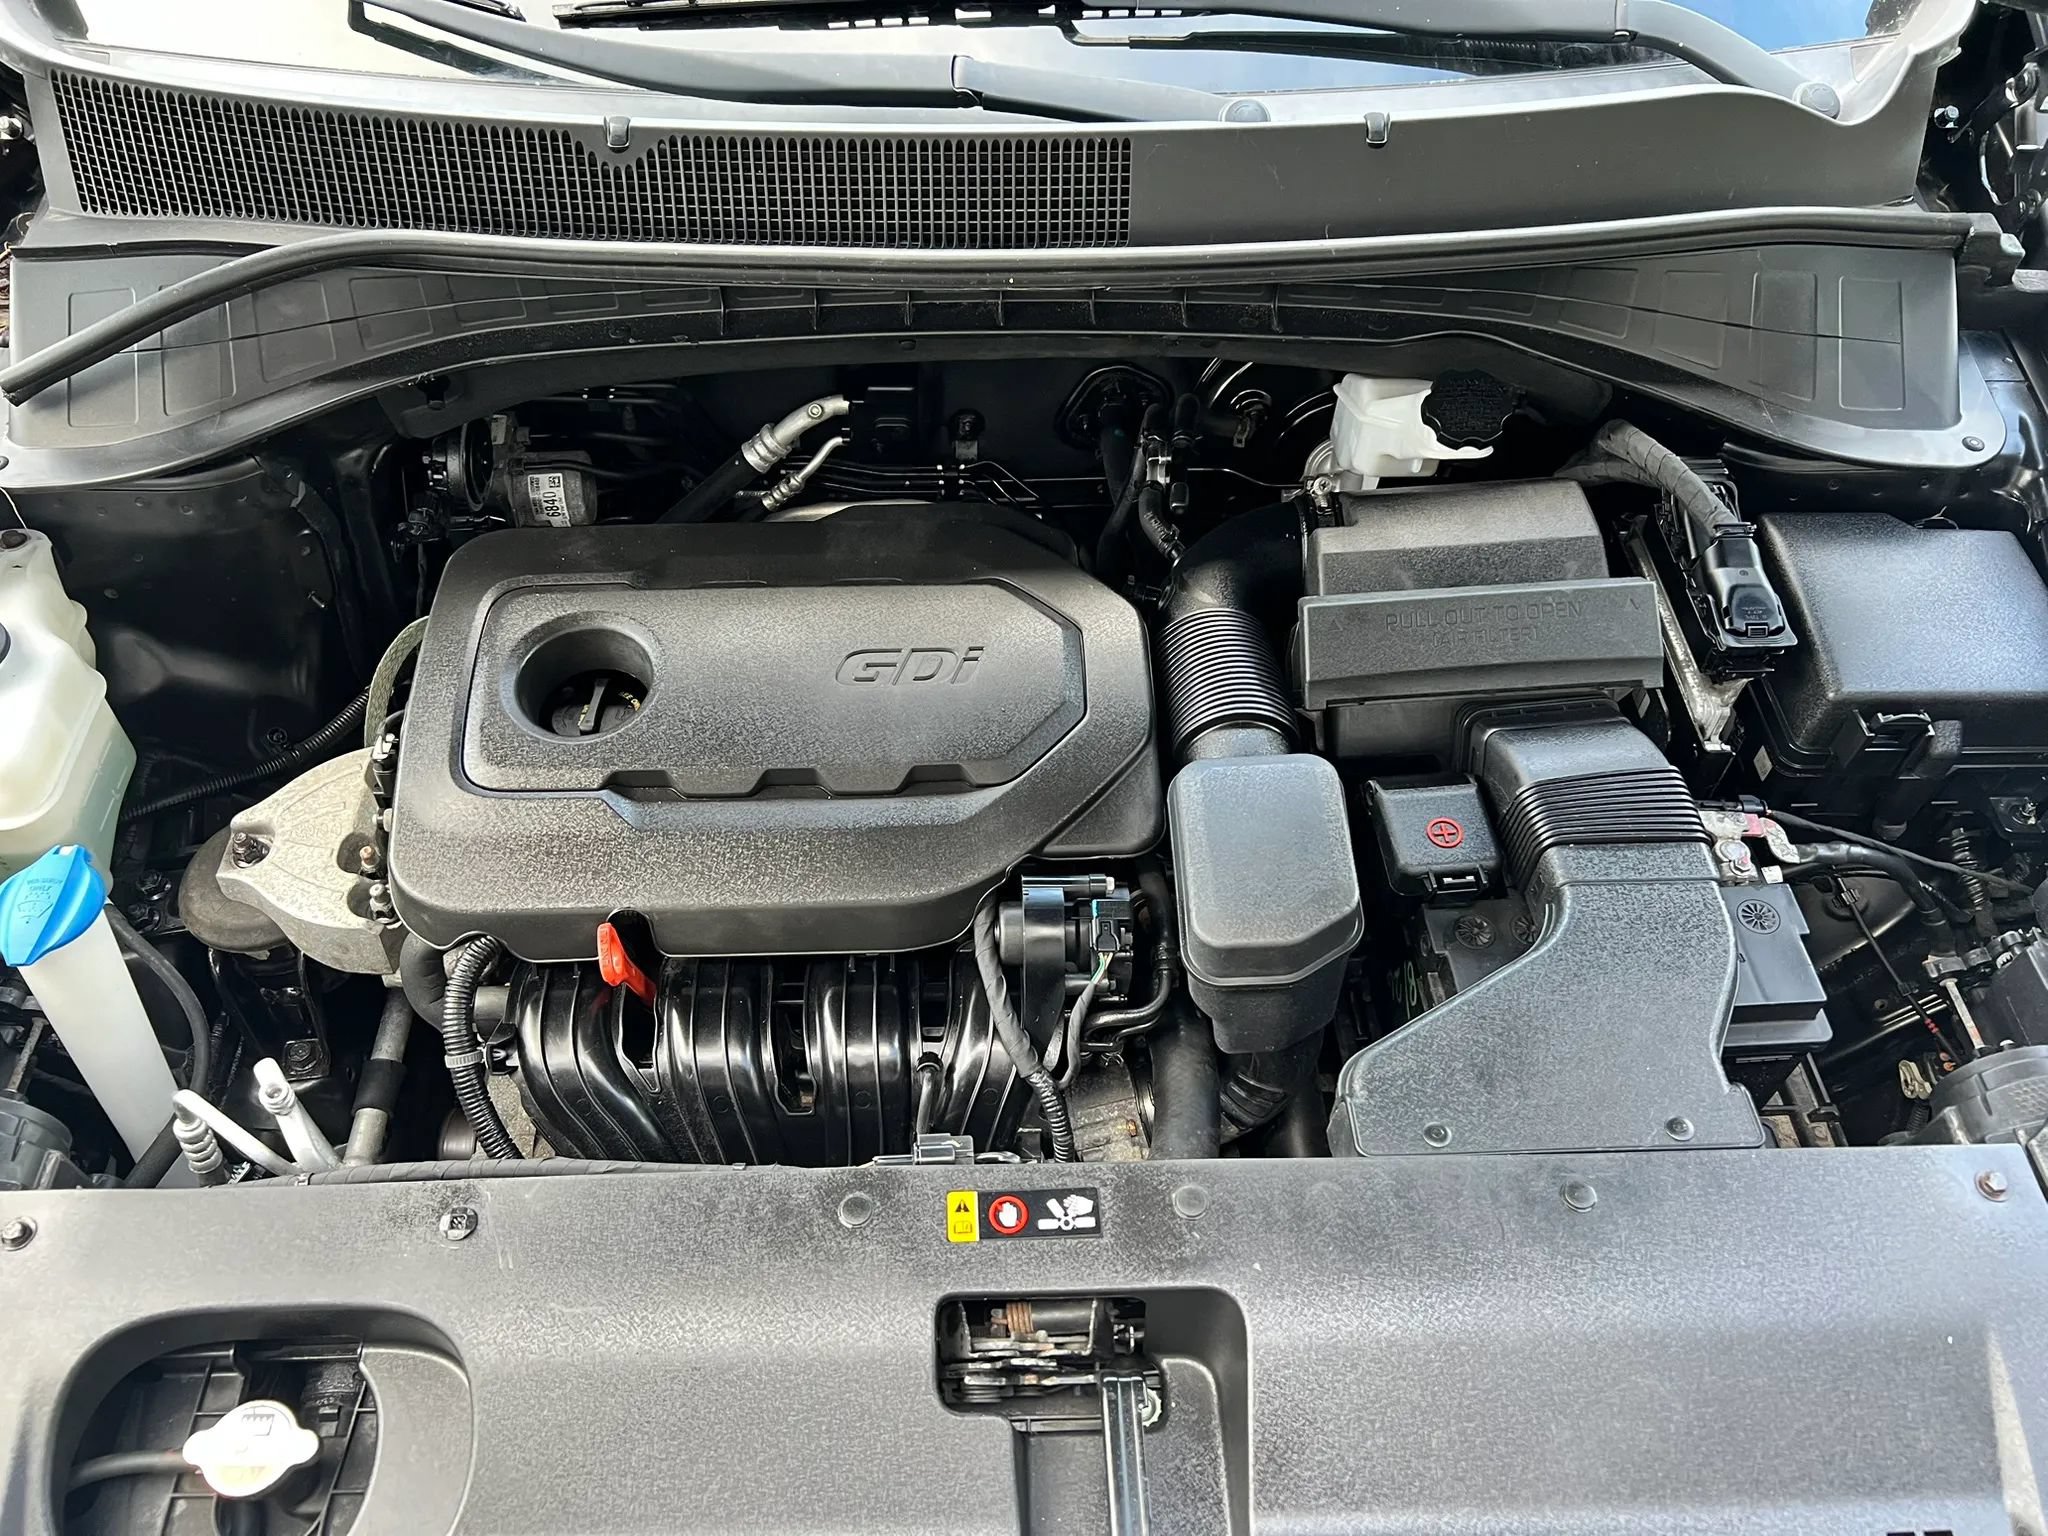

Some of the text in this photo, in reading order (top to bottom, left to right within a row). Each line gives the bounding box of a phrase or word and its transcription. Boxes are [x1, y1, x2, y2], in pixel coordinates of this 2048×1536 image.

[543, 491, 561, 517] 6840
[1385, 599, 1583, 631] PULL OUT TO OPEN
[835, 645, 986, 687] GDi
